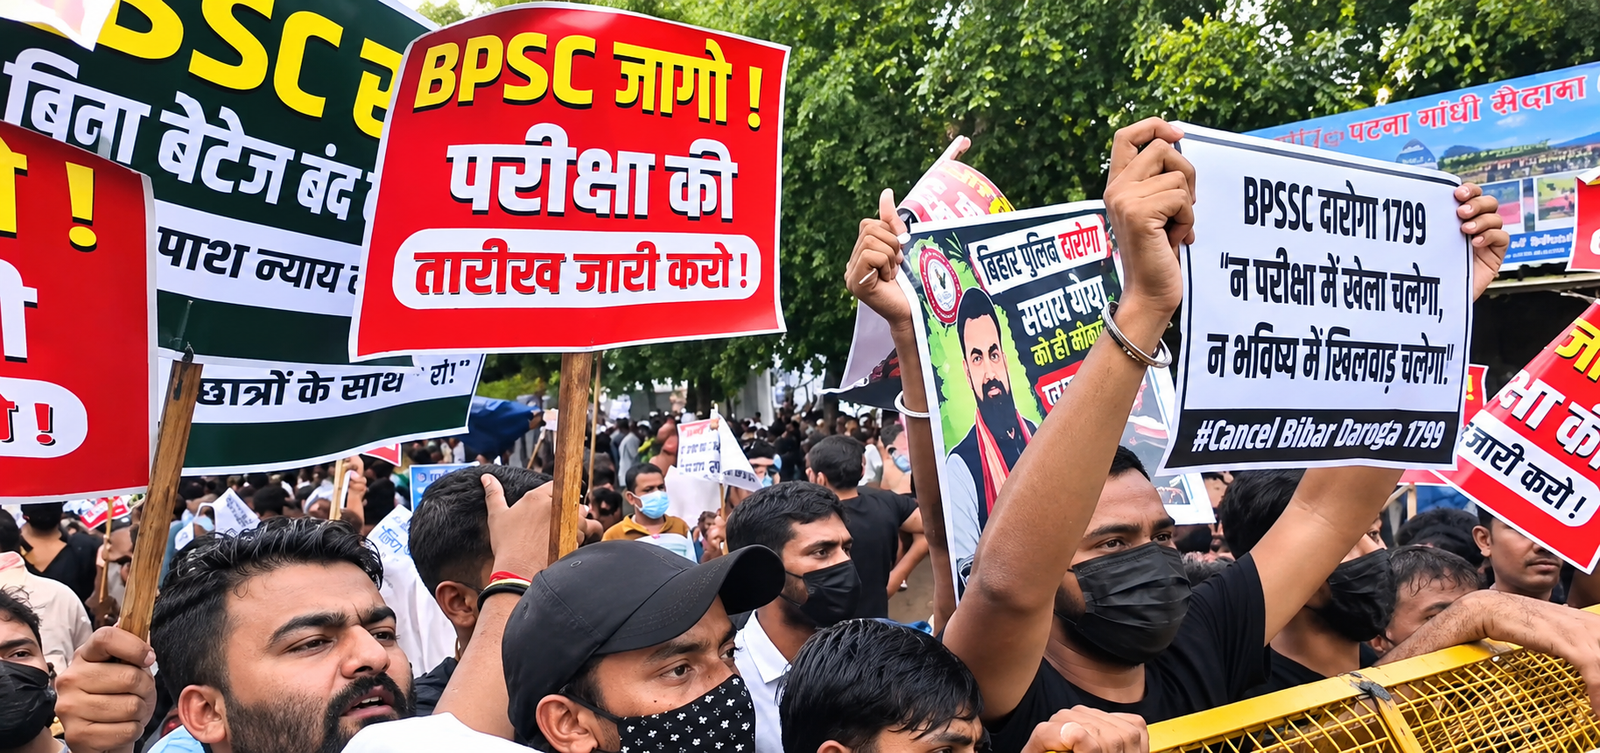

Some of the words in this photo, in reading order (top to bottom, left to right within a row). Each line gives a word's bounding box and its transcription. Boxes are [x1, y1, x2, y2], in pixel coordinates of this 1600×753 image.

[413, 32, 596, 111] BPSC
[613, 38, 732, 125] जागो
[747, 66, 763, 129] !
[1348, 112, 1411, 142] पटना
[1418, 94, 1481, 129] गांधी
[297, 143, 363, 221] बंद
[446, 123, 656, 217] परीक्षा
[665, 138, 739, 222] की
[1243, 176, 1314, 232] BPSSC
[1318, 180, 1379, 240] दारोगा
[1382, 198, 1427, 246] 1799
[255, 248, 345, 294] न्याय
[413, 238, 566, 295] तारीख
[573, 241, 661, 294] जारी
[667, 242, 733, 290] करो
[976, 244, 1023, 285] बिहार
[1058, 221, 1102, 260] दारोगा
[1253, 247, 1317, 306] परीक्षा
[1319, 252, 1341, 308] में
[1341, 255, 1388, 312] खेला
[1390, 262, 1444, 323] चलेगा,
[1030, 336, 1054, 367] को
[1050, 328, 1071, 361] ही
[1207, 333, 1229, 378] न
[1232, 321, 1300, 380] भविष्य
[1302, 325, 1324, 381] में
[1324, 326, 1399, 394] खिलवाड़
[1553, 317, 1600, 382] जा
[197, 370, 293, 406] छात्रों
[297, 371, 335, 405] के
[341, 371, 405, 402] साथ
[1191, 416, 1282, 452] #Cancel
[1333, 418, 1404, 451] Daroga
[1402, 420, 1447, 449] 1799
[1520, 462, 1575, 510] करो
[1568, 496, 1587, 519] !
